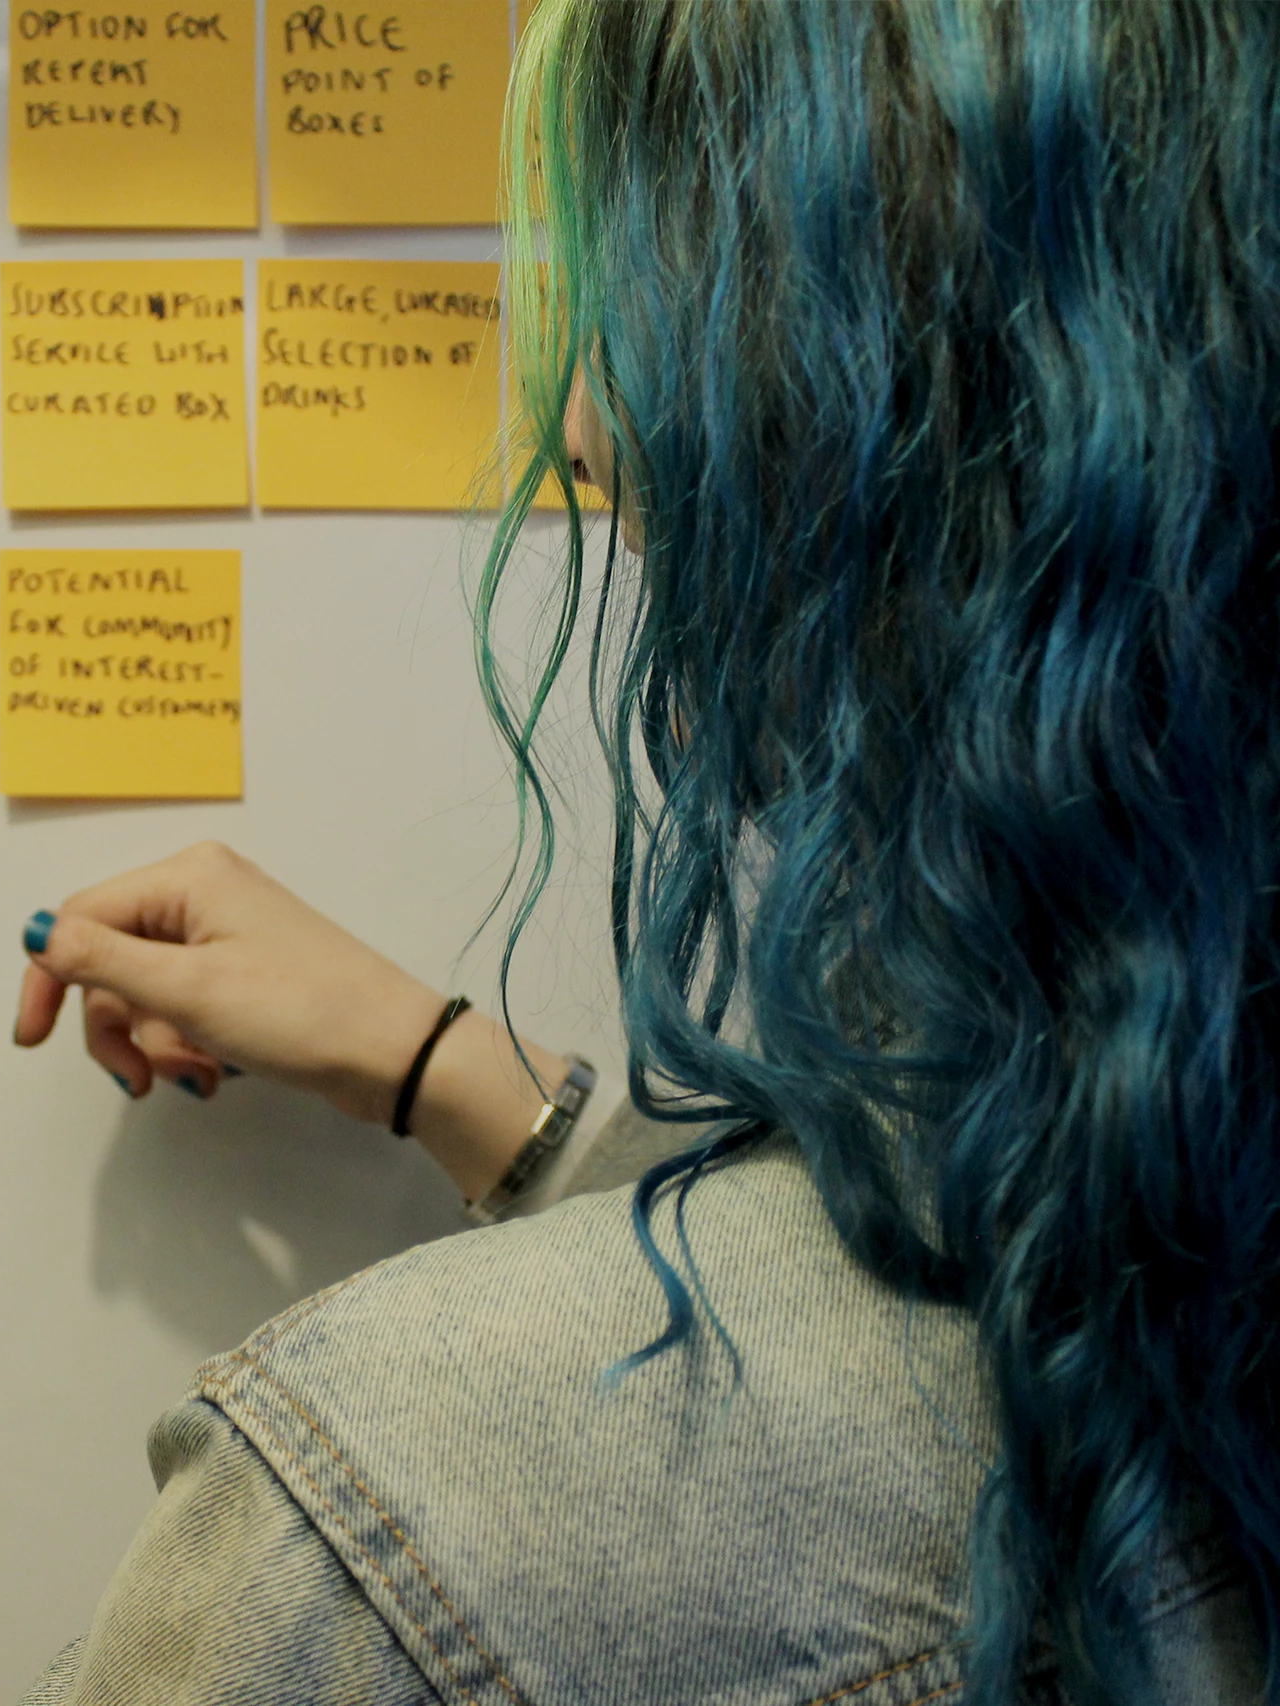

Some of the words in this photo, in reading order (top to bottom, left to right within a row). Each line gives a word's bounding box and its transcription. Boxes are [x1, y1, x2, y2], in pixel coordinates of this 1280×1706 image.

[19, 8, 148, 42] OPTION
[166, 11, 230, 44] FOR
[283, 7, 407, 53] PRICE
[22, 58, 149, 88] REPEAT
[282, 67, 392, 95] POINT
[414, 62, 456, 88] OF
[26, 99, 181, 134] DELIVERY
[286, 106, 384, 137] BOXES
[12, 333, 132, 366] SERVICE
[154, 339, 230, 366] WITH
[262, 326, 432, 369] SELECTION
[450, 340, 479, 366] OF
[6, 391, 156, 417] CURATED
[176, 390, 231, 421] BOX
[262, 380, 367, 419] DRINKS
[8, 567, 191, 595] POTENTIAL
[9, 608, 67, 637] FOR
[83, 613, 233, 652] COMMUNITY
[9, 652, 41, 678] OF
[8, 690, 105, 719] DRIVEN
